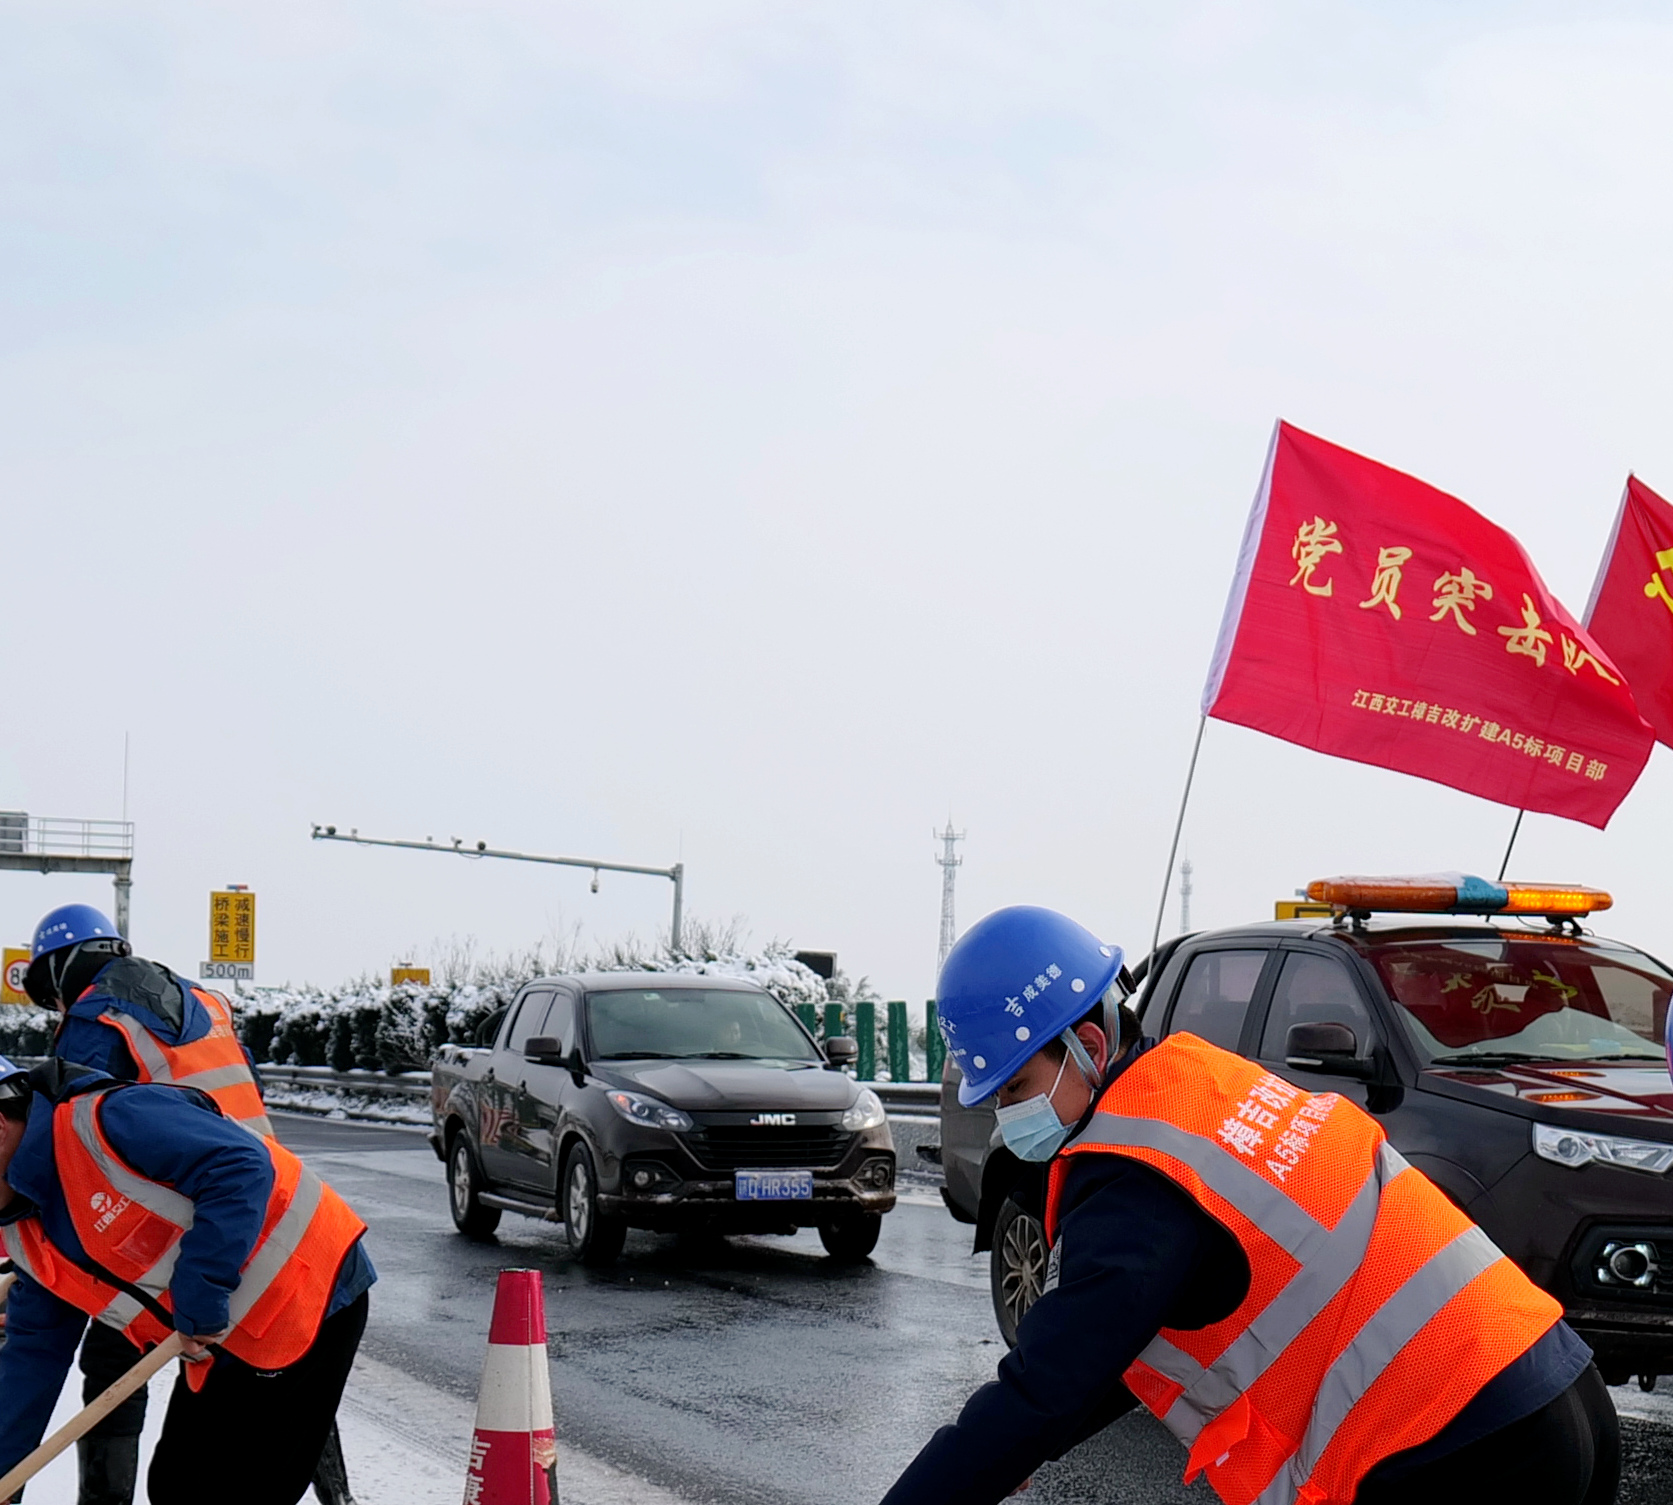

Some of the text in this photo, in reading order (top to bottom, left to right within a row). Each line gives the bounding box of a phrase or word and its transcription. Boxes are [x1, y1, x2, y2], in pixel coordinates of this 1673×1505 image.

[1351, 688, 1608, 782] 江西交工樟吉改扩建A5标项目部
[214, 896, 229, 957] 桥梁施工
[234, 897, 250, 958] 减速慢行
[206, 964, 249, 978] 500m
[750, 1113, 796, 1126] JMC
[93, 1195, 131, 1233] 江西交工
